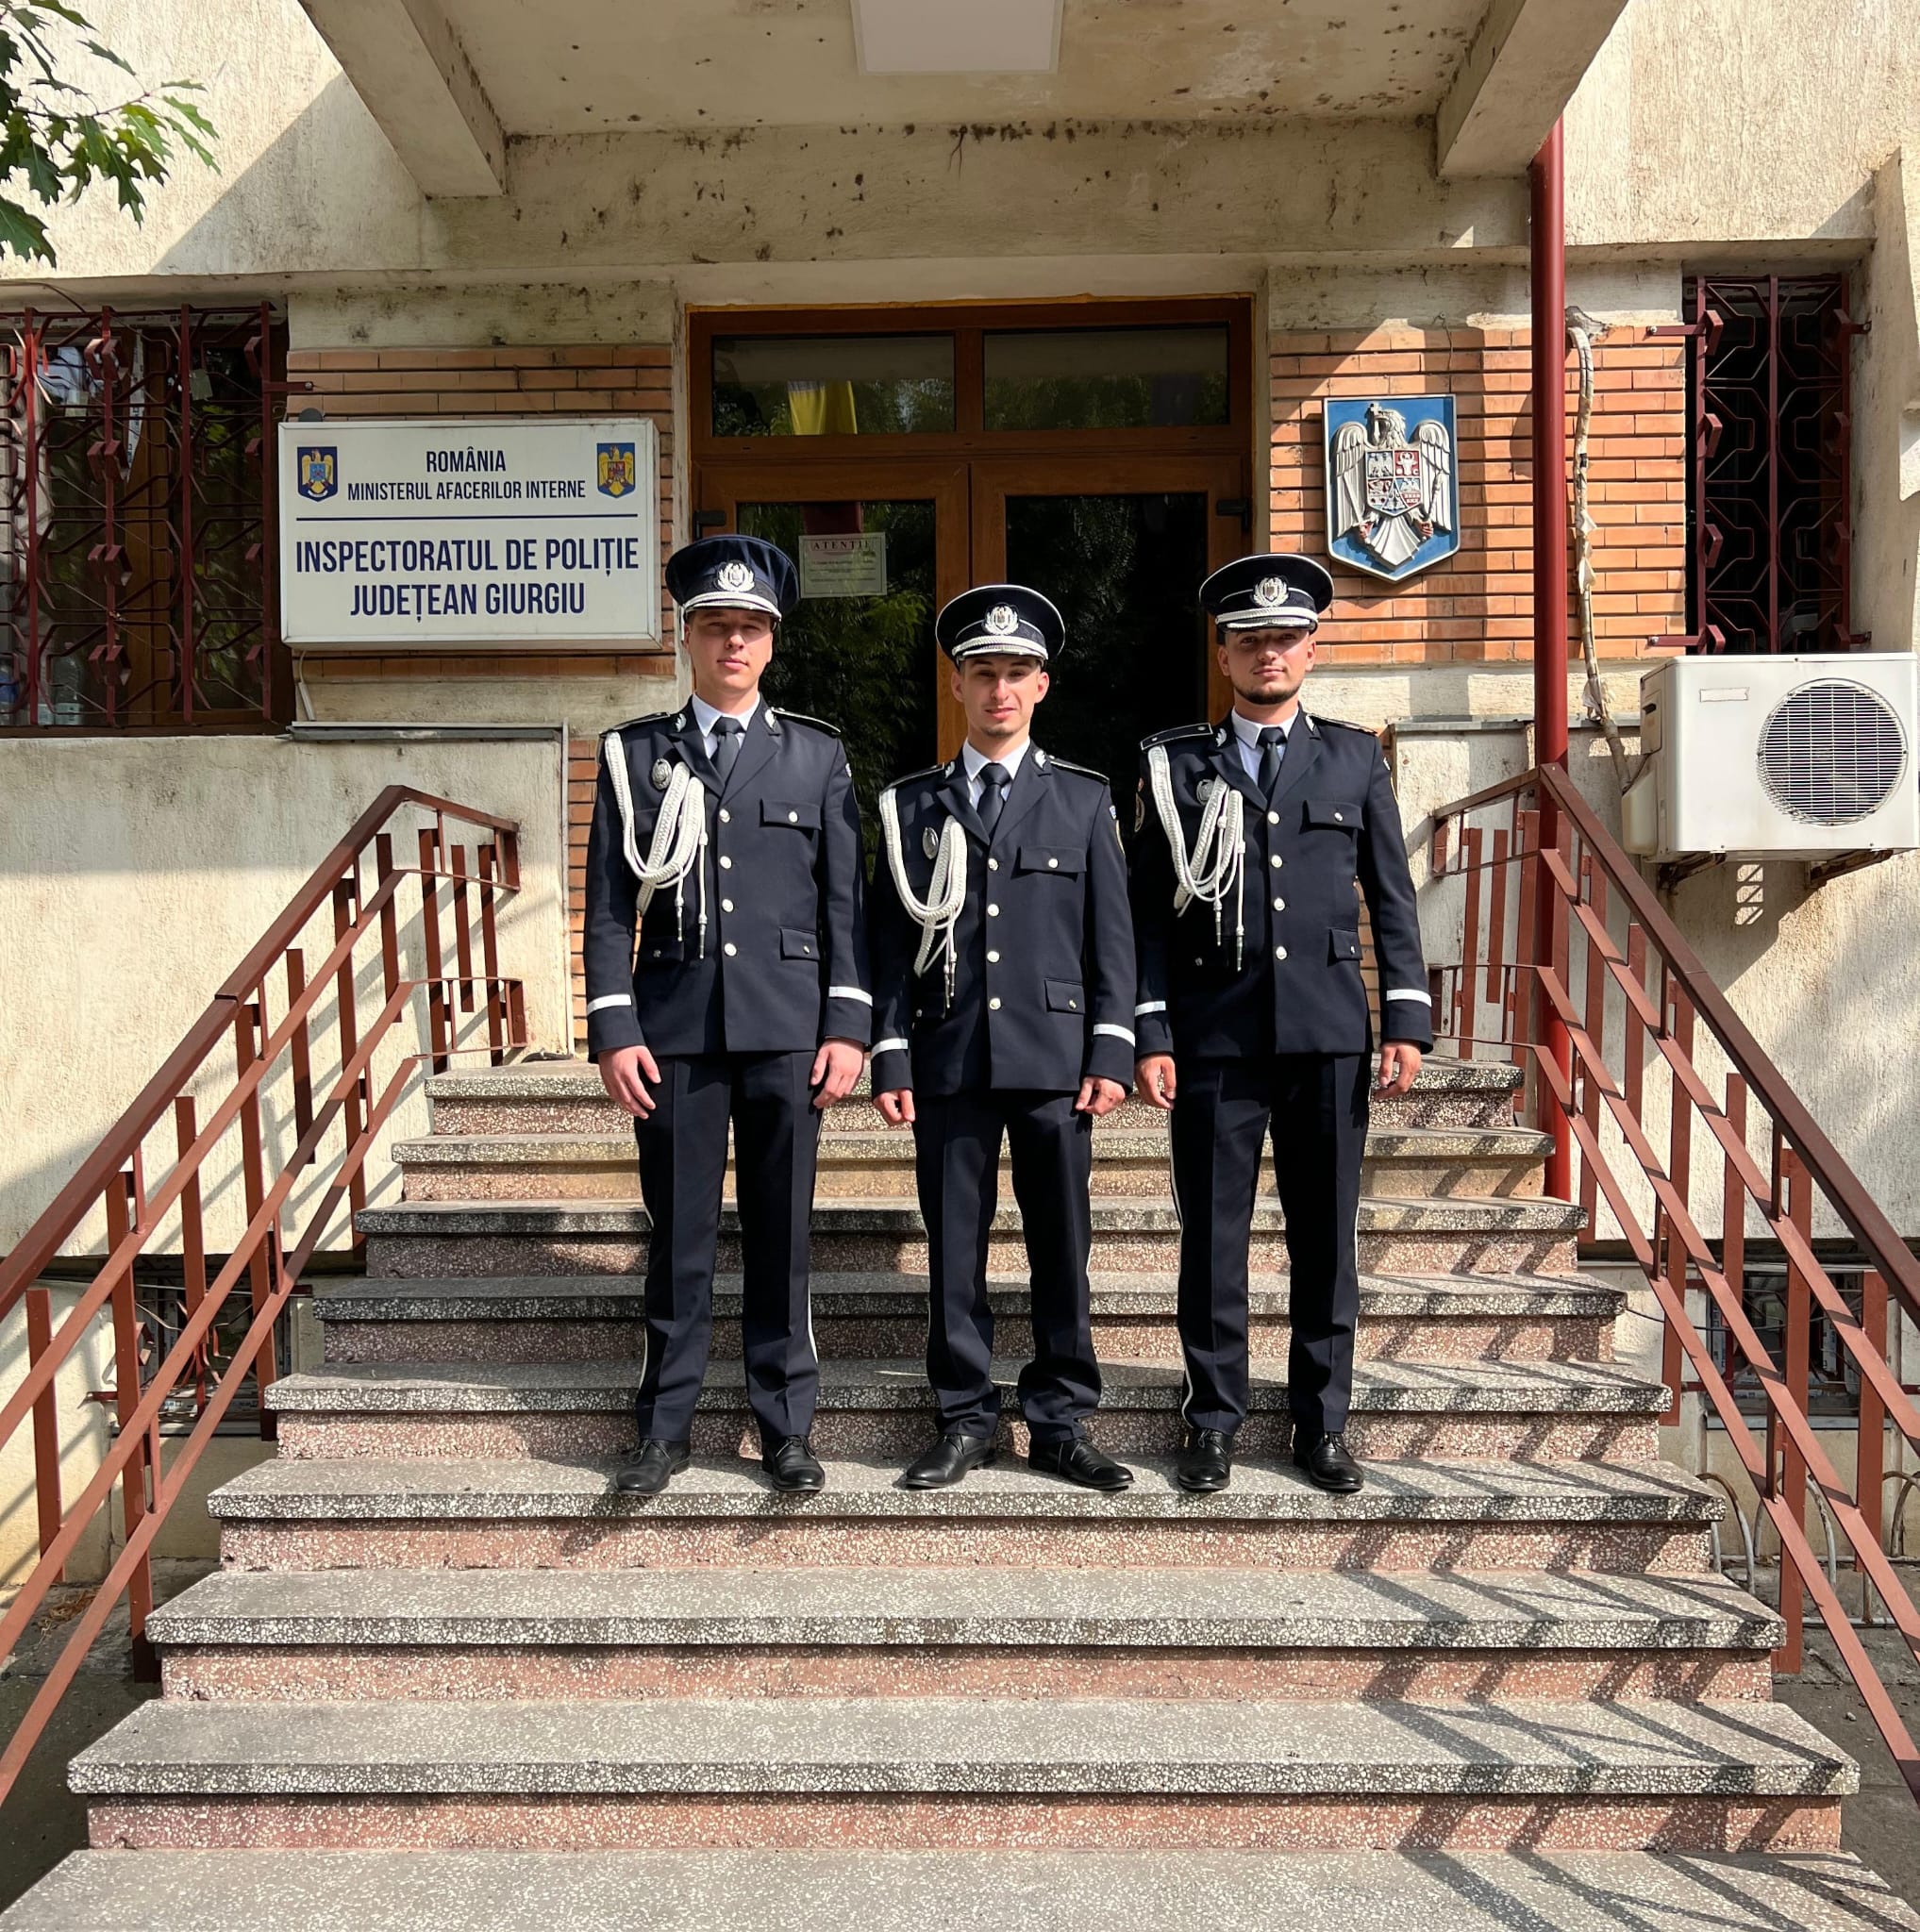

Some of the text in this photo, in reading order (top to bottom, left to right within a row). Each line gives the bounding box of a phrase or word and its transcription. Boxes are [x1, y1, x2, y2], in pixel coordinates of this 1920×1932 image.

[426, 446, 507, 473] ROMÂNIA
[348, 479, 586, 501] MINISTERUL AFACERILOR INTERNE
[296, 537, 639, 576] INSPECTORATUL DE POLIȚIE
[350, 582, 585, 623] JUDEȚEAN GIURGIU
